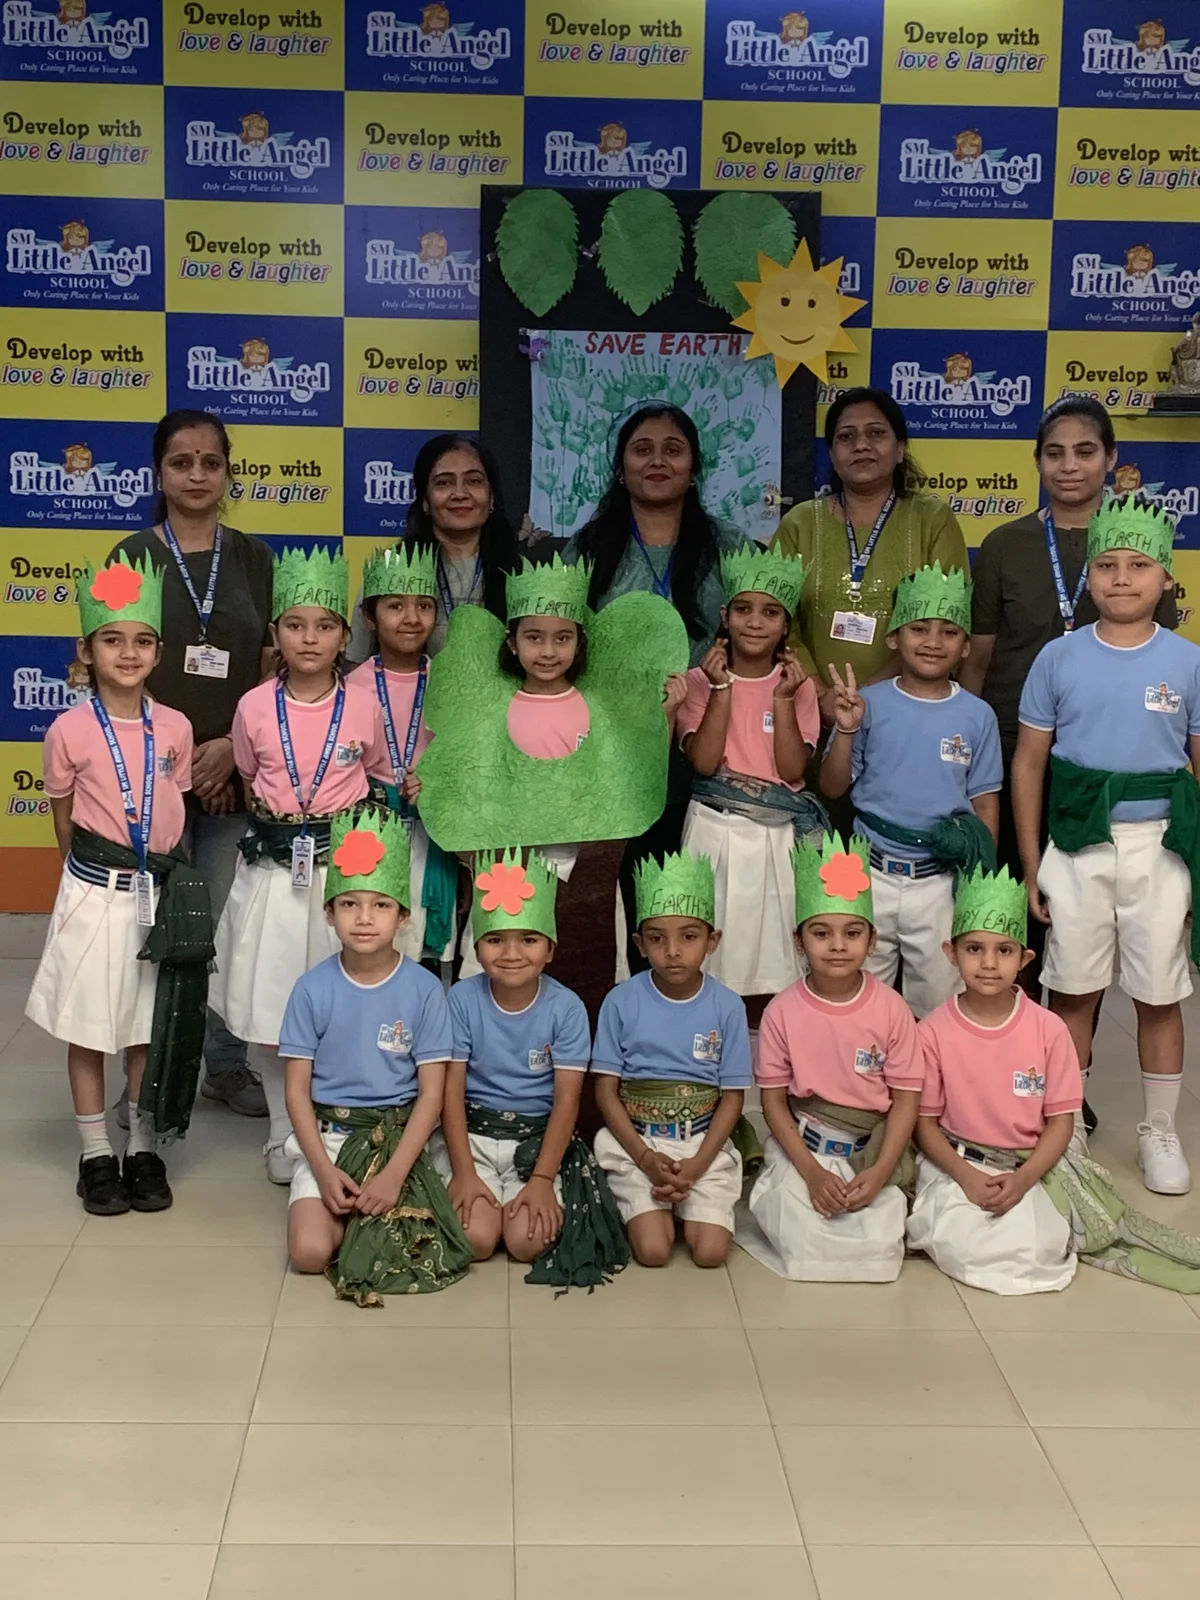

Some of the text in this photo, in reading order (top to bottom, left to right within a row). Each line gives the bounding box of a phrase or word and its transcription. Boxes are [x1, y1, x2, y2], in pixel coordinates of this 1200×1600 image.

[7, 4, 26, 16] SM
[185, 3, 322, 31] Develop with
[371, 15, 390, 27] SM
[9, 19, 145, 54] Little Angel
[546, 13, 682, 41] Develop with
[730, 24, 750, 36] SM
[904, 21, 1039, 49] Develop with
[1087, 32, 1107, 44] SM
[179, 31, 329, 56] love & laughter
[372, 30, 507, 65] Little Angel
[540, 42, 689, 65] love & laughter
[47, 50, 106, 62] SCHOOL
[410, 60, 468, 71] SCHOOL
[731, 39, 865, 74] Little Angel
[898, 50, 1046, 73] love & laughter
[1088, 47, 1146, 69] Little
[768, 69, 826, 80] SCHOOL
[1124, 77, 1182, 88] SCHOOL
[4, 112, 141, 140] Develop with
[190, 124, 210, 136] SM
[366, 123, 501, 151] Develop with
[0, 140, 149, 164] love & laughter
[549, 135, 568, 147] SM
[723, 132, 856, 159] Develop with
[905, 142, 924, 154] SM
[1077, 138, 1200, 166] Develop wit
[191, 139, 326, 174] Little Angel
[360, 151, 508, 175] love & laughter
[550, 149, 683, 184] Little Angel
[229, 169, 288, 181] SCHOOL
[716, 160, 863, 183] love & laughter
[905, 157, 1038, 190] Little Angel
[1070, 167, 1132, 185] love &
[942, 186, 999, 197] SCHOOL
[10, 232, 30, 244] SM
[186, 231, 322, 259] Develop with
[370, 243, 389, 255] SM
[12, 247, 147, 282] Little Angel
[181, 259, 329, 283] love & laughter
[371, 258, 430, 281] Little
[895, 246, 1029, 274] Develop with
[1076, 257, 1095, 269] SM
[51, 277, 109, 288] SCHOOL
[889, 275, 1035, 298] love & laughter
[1077, 271, 1200, 305] Little Ange
[1112, 300, 1170, 311] SCHOOL
[7, 337, 143, 366] Develop with
[586, 331, 742, 356] SAVE EARTH
[192, 350, 211, 362] SM
[365, 348, 447, 375] Develop
[3, 365, 151, 389] love & laughter
[193, 364, 326, 398] Little Angel
[895, 365, 914, 377] SM
[359, 375, 421, 394] love &
[896, 379, 1027, 412] Little Angel
[231, 393, 289, 404] SCHOOL
[932, 408, 989, 419] SCHOOL
[924, 421, 948, 430] Caring
[14, 455, 34, 467] SM
[280, 460, 321, 477] with
[369, 465, 388, 477] SM
[16, 469, 149, 503] Little Angel
[229, 482, 329, 504] & laughter
[977, 473, 1017, 490] with
[27, 510, 45, 520] Only
[47, 511, 72, 520] Caring
[73, 512, 94, 520] Place
[94, 512, 105, 520] for
[54, 498, 112, 509] SCHOOL
[1105, 528, 1152, 552] EARTH
[11, 556, 88, 581] Develo
[6, 584, 68, 602] love &
[388, 574, 432, 594] EARTH
[752, 570, 798, 607] EARTH
[292, 582, 338, 611] EARTH
[535, 597, 577, 619] EARTH
[18, 671, 37, 682] SM
[19, 684, 78, 707] Little
[8, 796, 49, 814] love
[650, 888, 700, 918] EARTH
